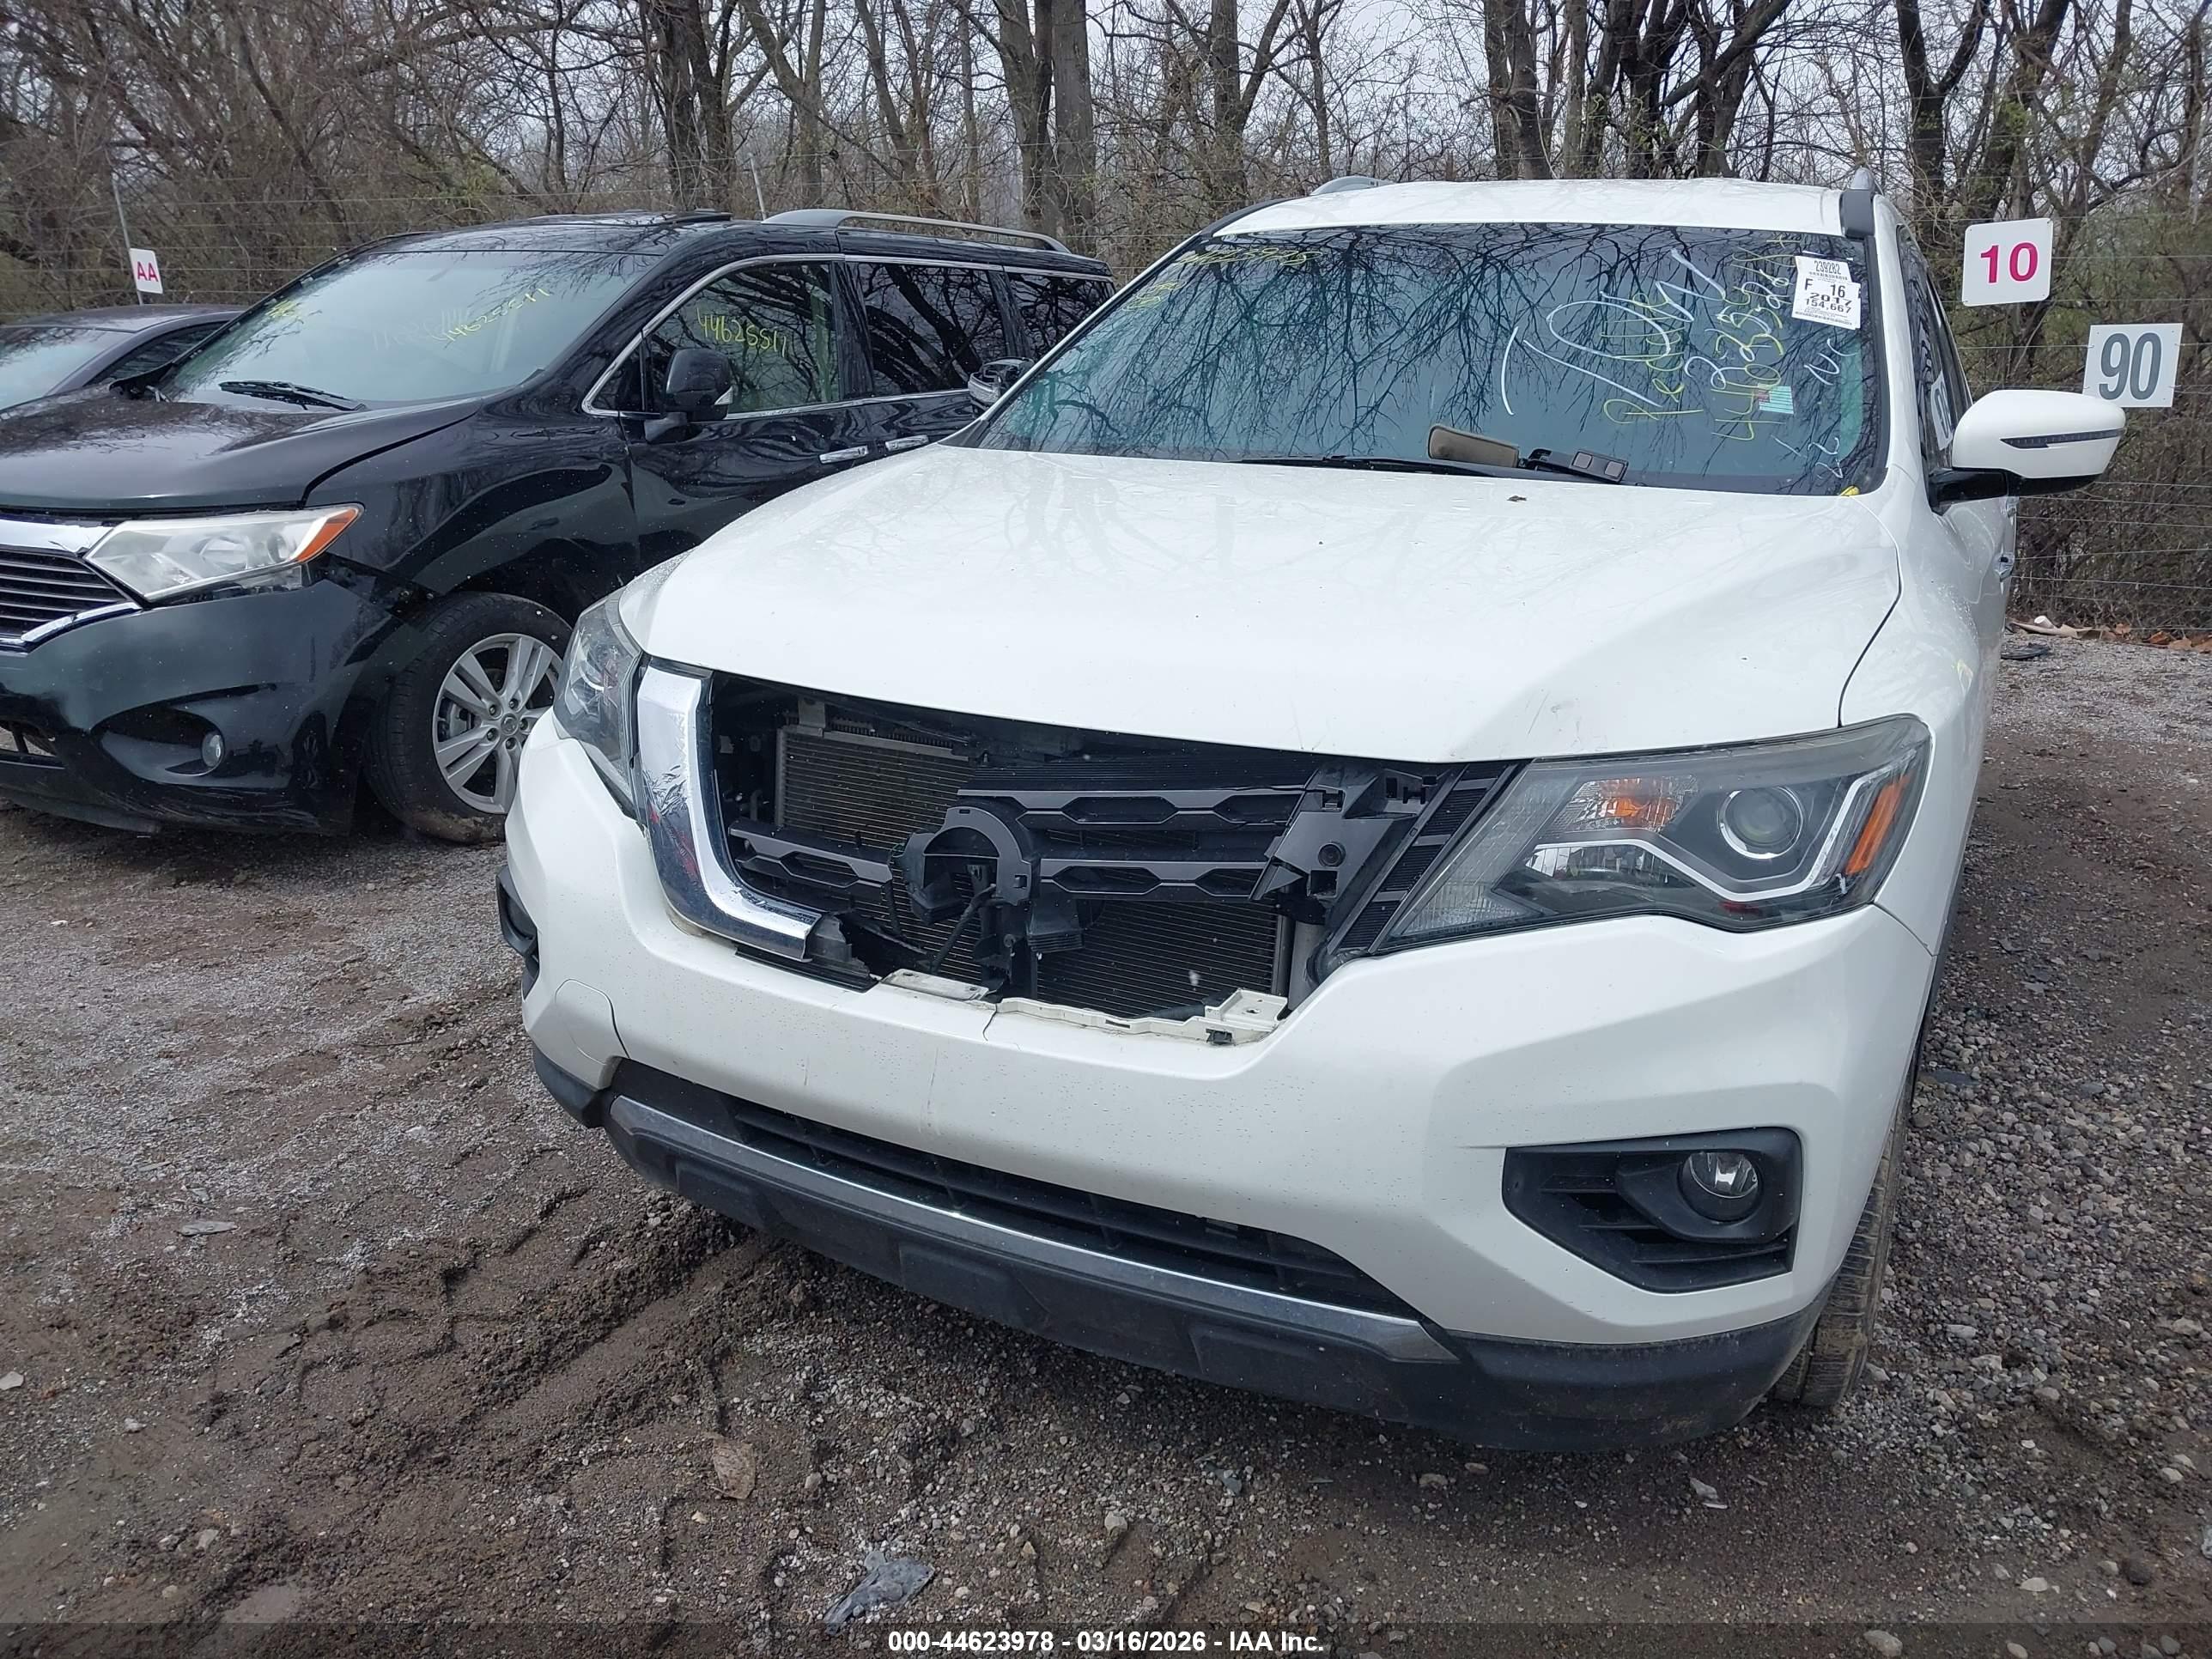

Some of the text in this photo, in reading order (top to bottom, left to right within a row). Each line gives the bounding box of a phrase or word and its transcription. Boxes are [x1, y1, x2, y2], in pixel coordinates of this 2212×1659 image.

[137, 261, 159, 283] AA
[1980, 241, 2039, 283] 10
[1804, 278, 1846, 298] F 16
[1806, 299, 1852, 313] 154,667
[1809, 293, 1852, 307] 2017
[2099, 332, 2162, 400] 90
